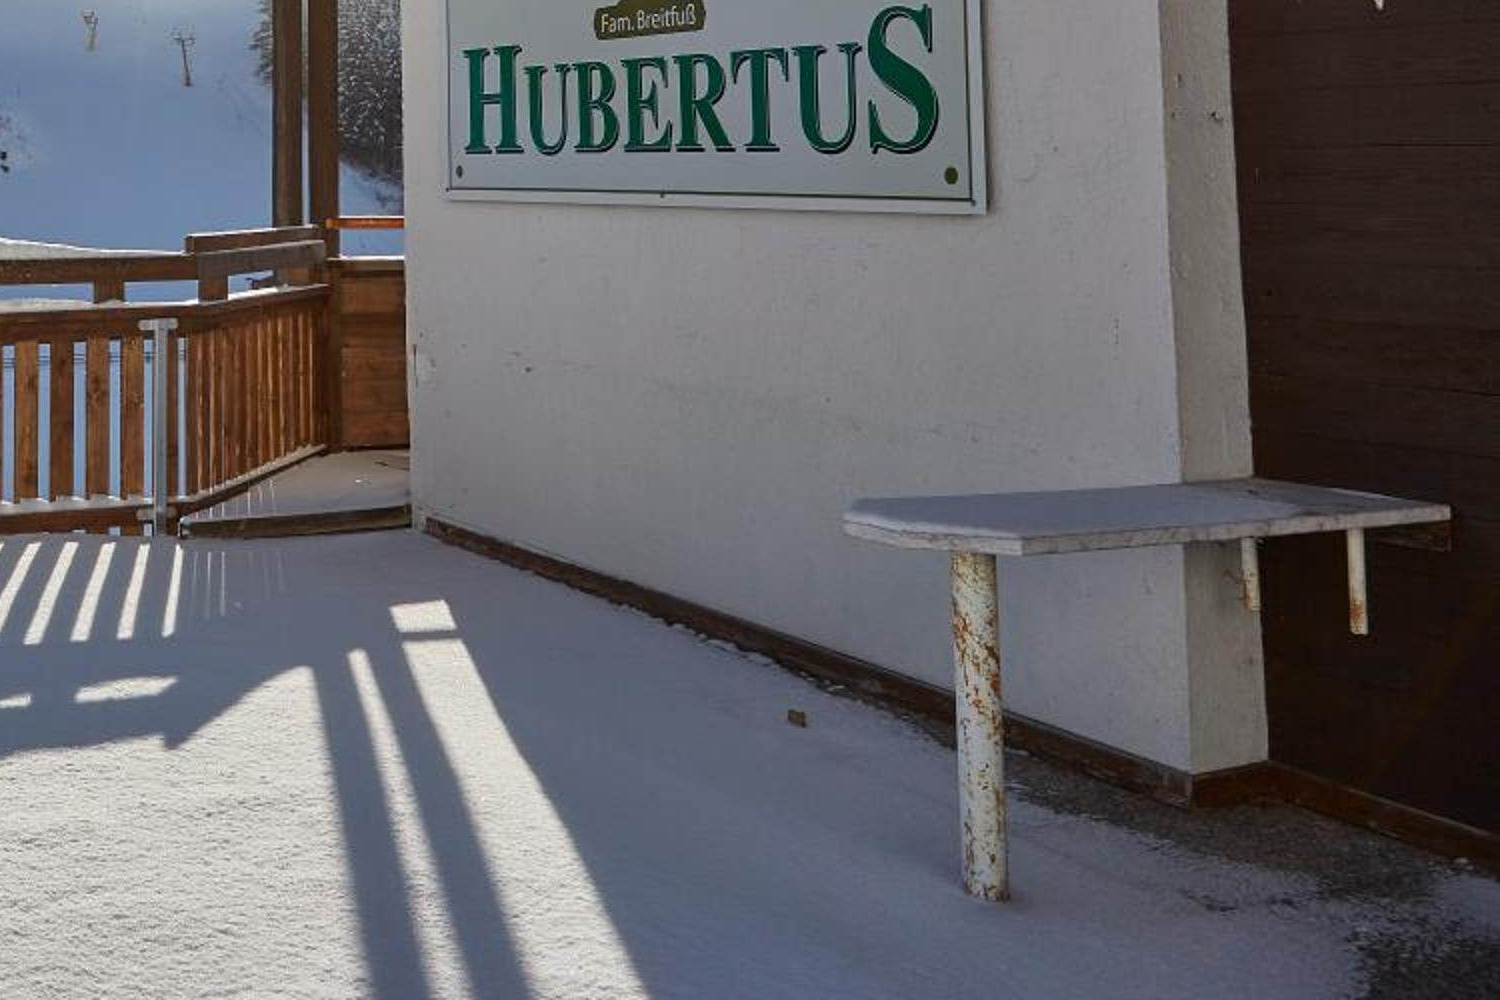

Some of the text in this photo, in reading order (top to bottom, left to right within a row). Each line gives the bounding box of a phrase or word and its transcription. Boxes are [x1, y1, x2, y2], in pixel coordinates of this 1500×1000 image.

[601, 3, 697, 33] Fam. Breitfuß
[463, 4, 939, 155] HUBERTUS
